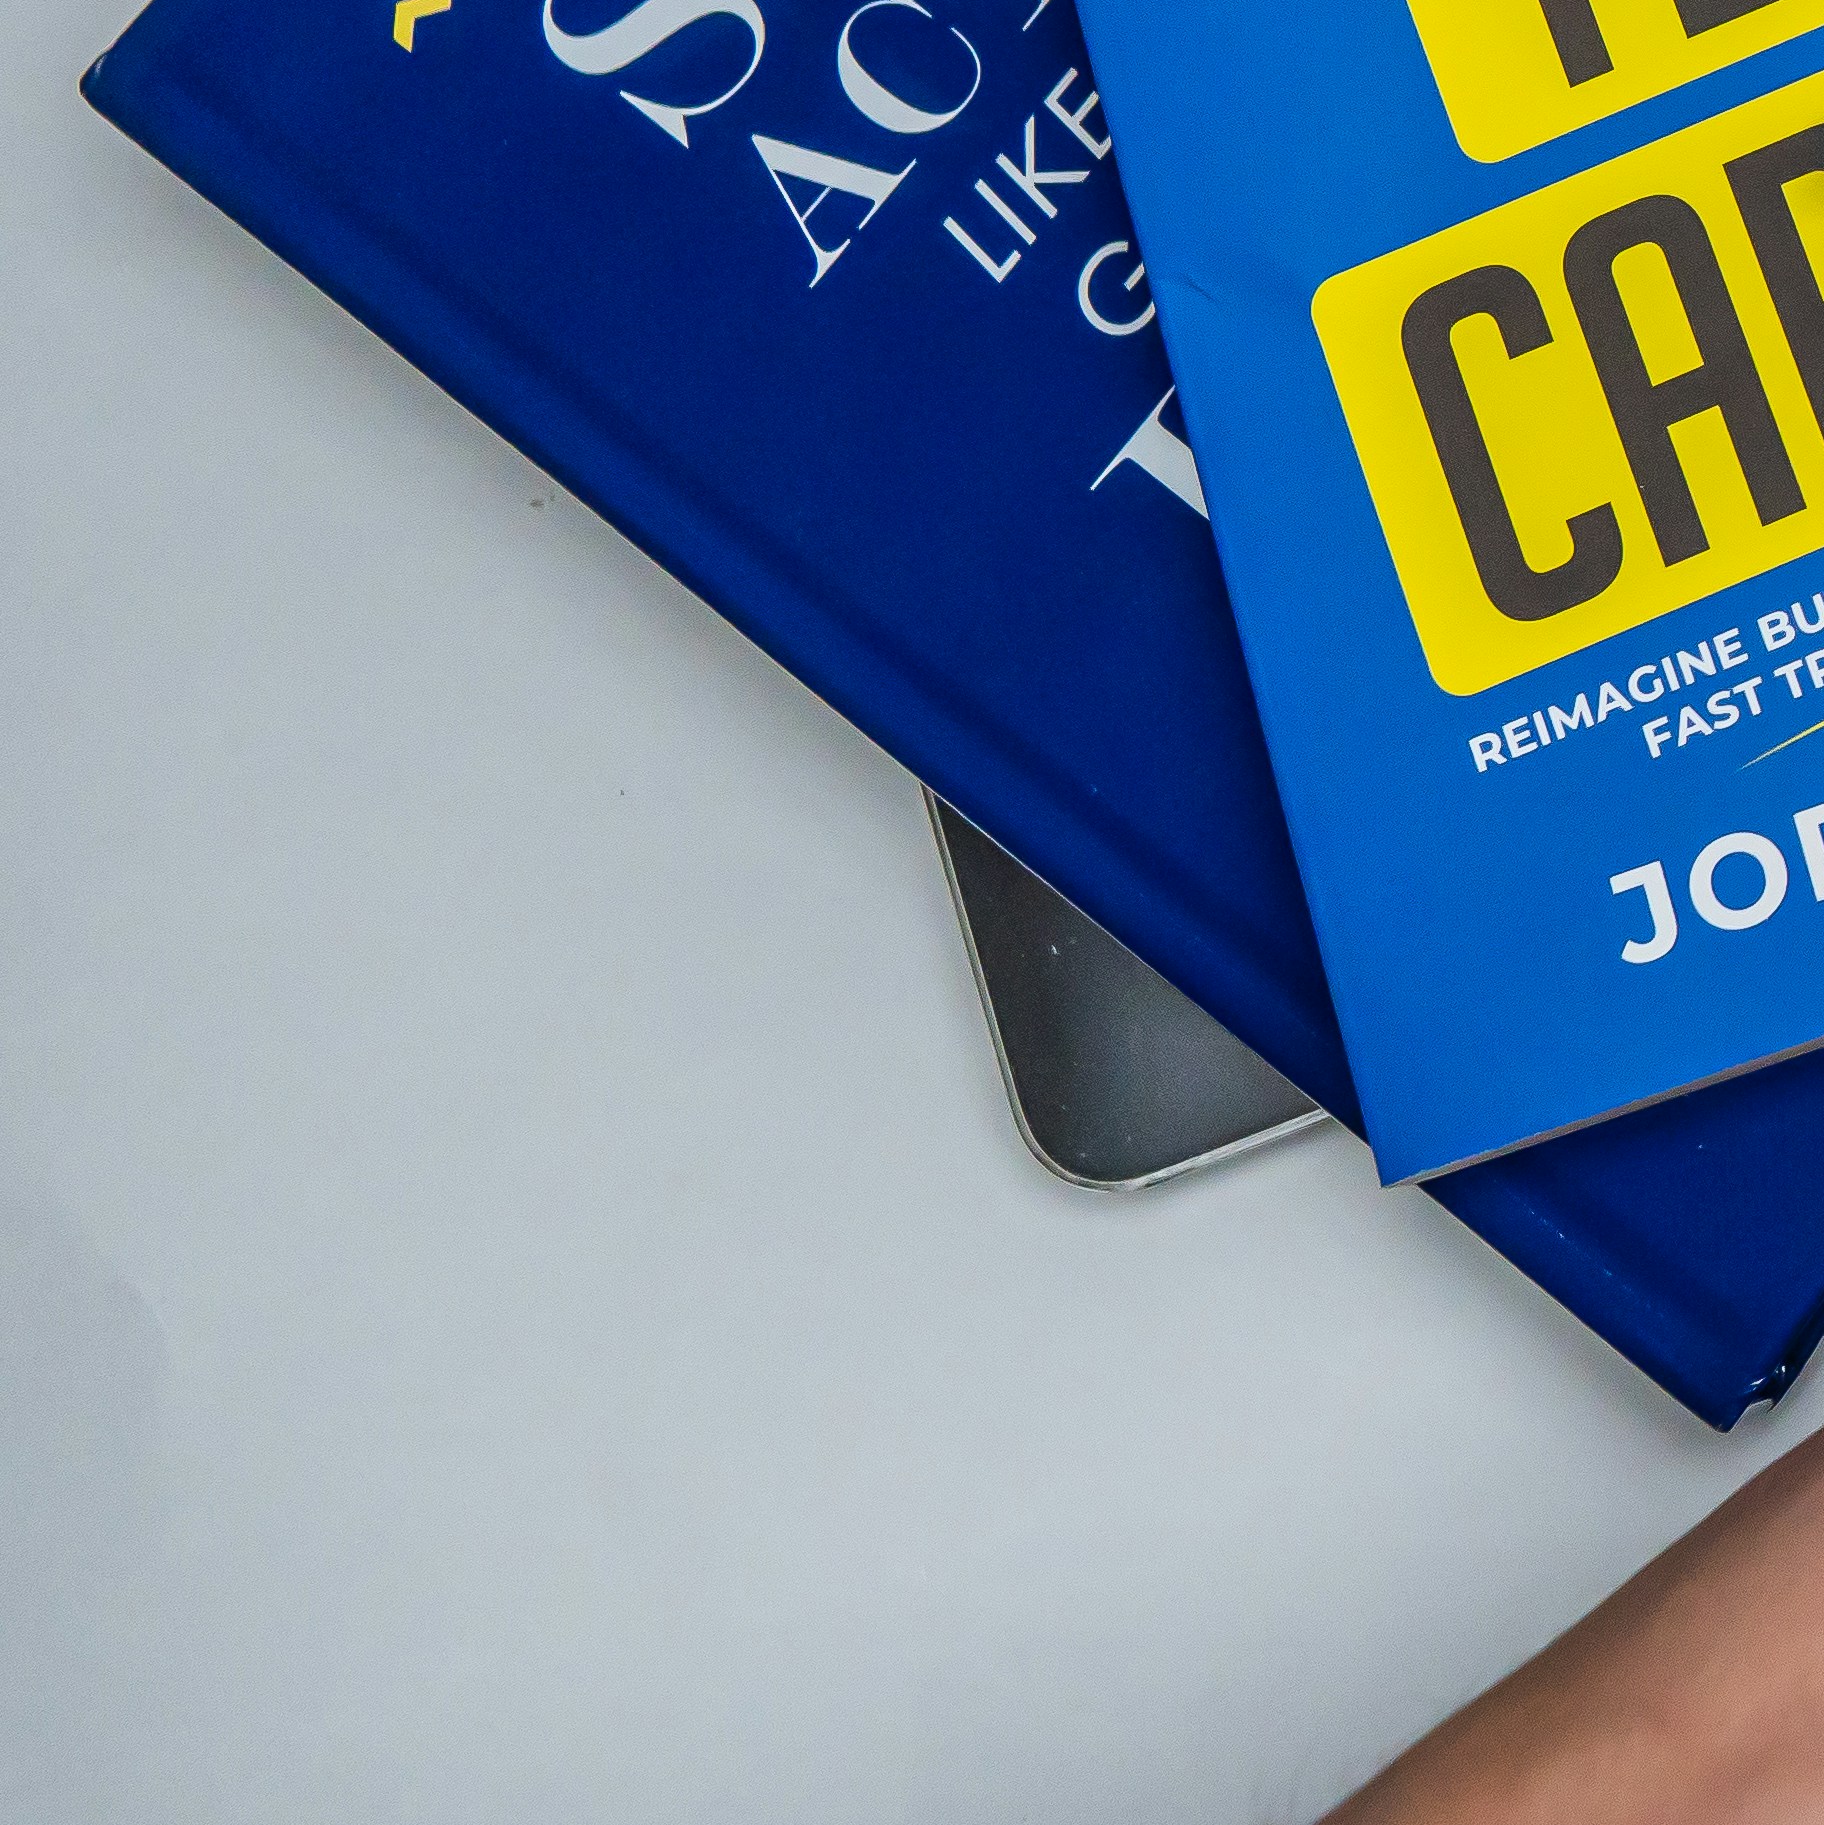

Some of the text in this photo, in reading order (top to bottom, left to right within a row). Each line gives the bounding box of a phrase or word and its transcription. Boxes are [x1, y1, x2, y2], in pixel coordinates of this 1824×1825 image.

[943, 67, 1112, 283] LIKE
[1469, 628, 1748, 772] REIMAGINE
[1643, 677, 1762, 758] FAST
